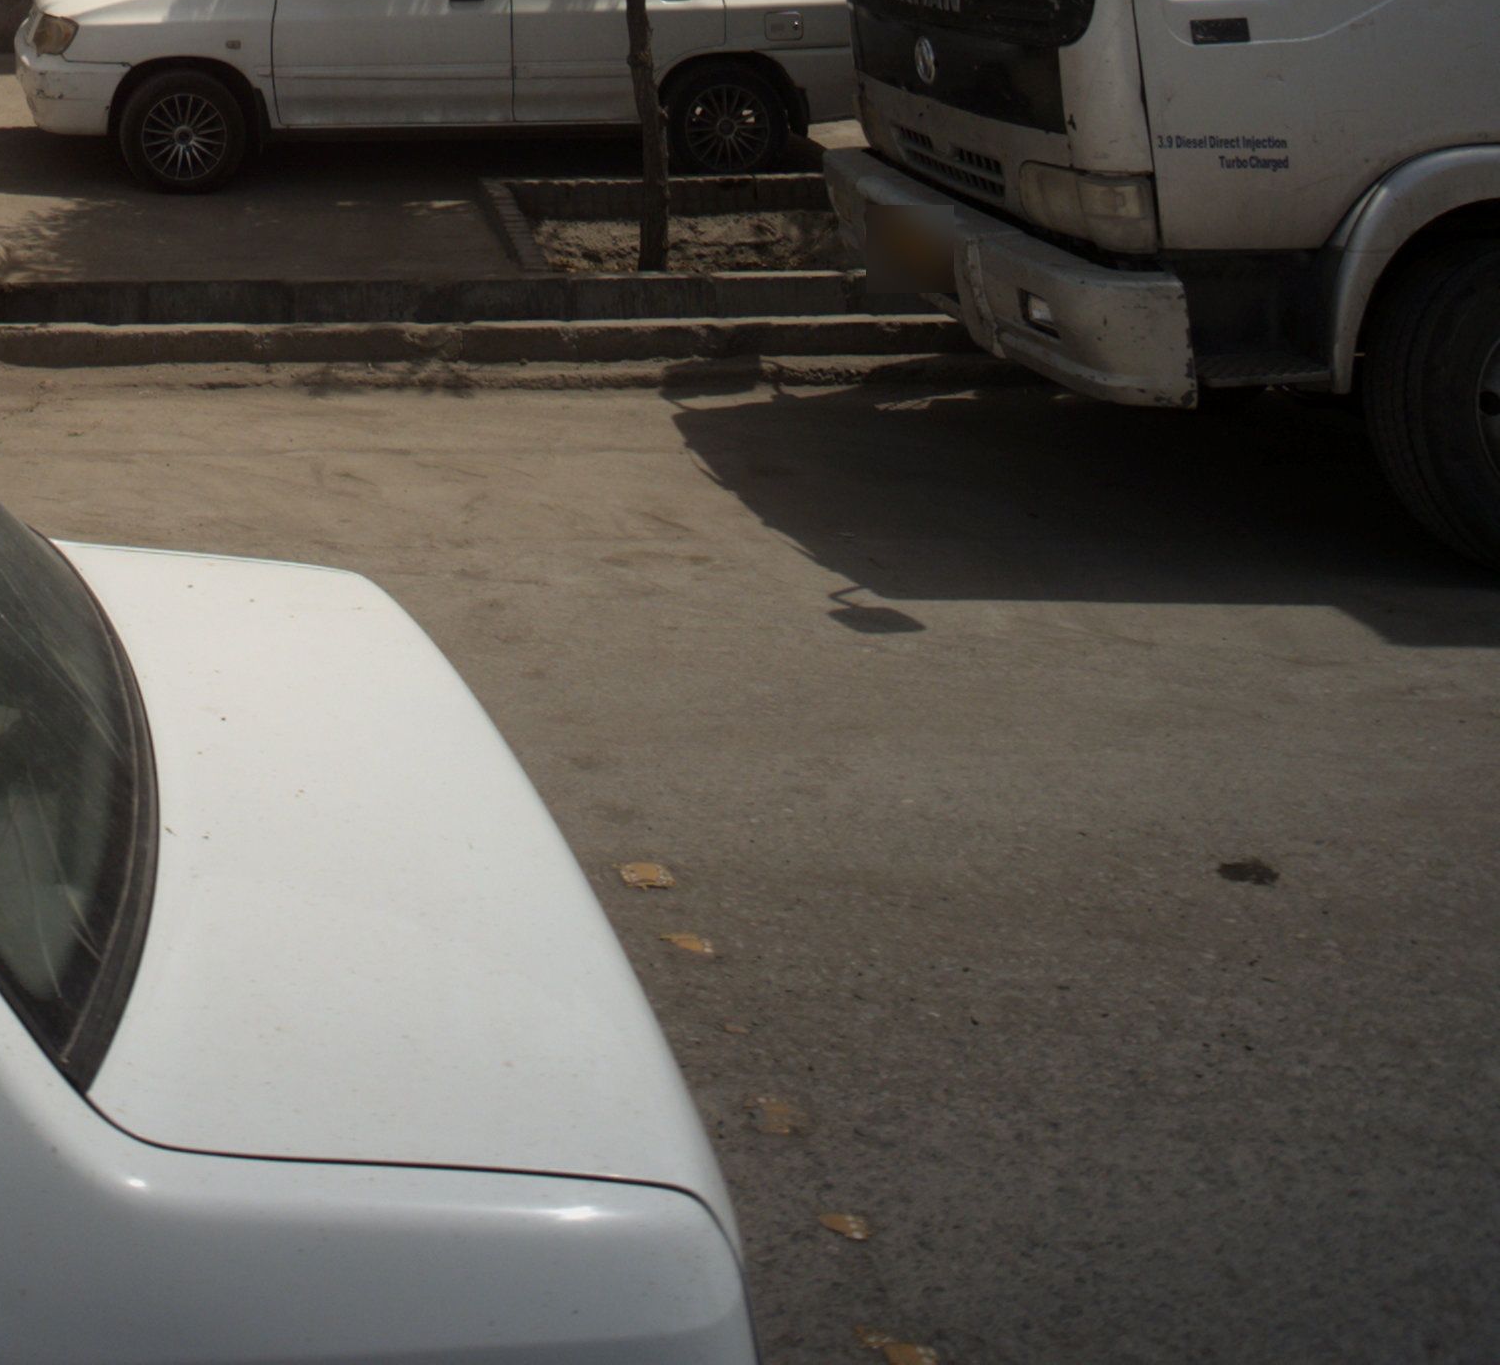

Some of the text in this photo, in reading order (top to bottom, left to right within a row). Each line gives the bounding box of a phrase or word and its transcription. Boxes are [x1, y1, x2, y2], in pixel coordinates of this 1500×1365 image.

[1157, 135, 1288, 152] 3.9 Diesel Direct Injection
